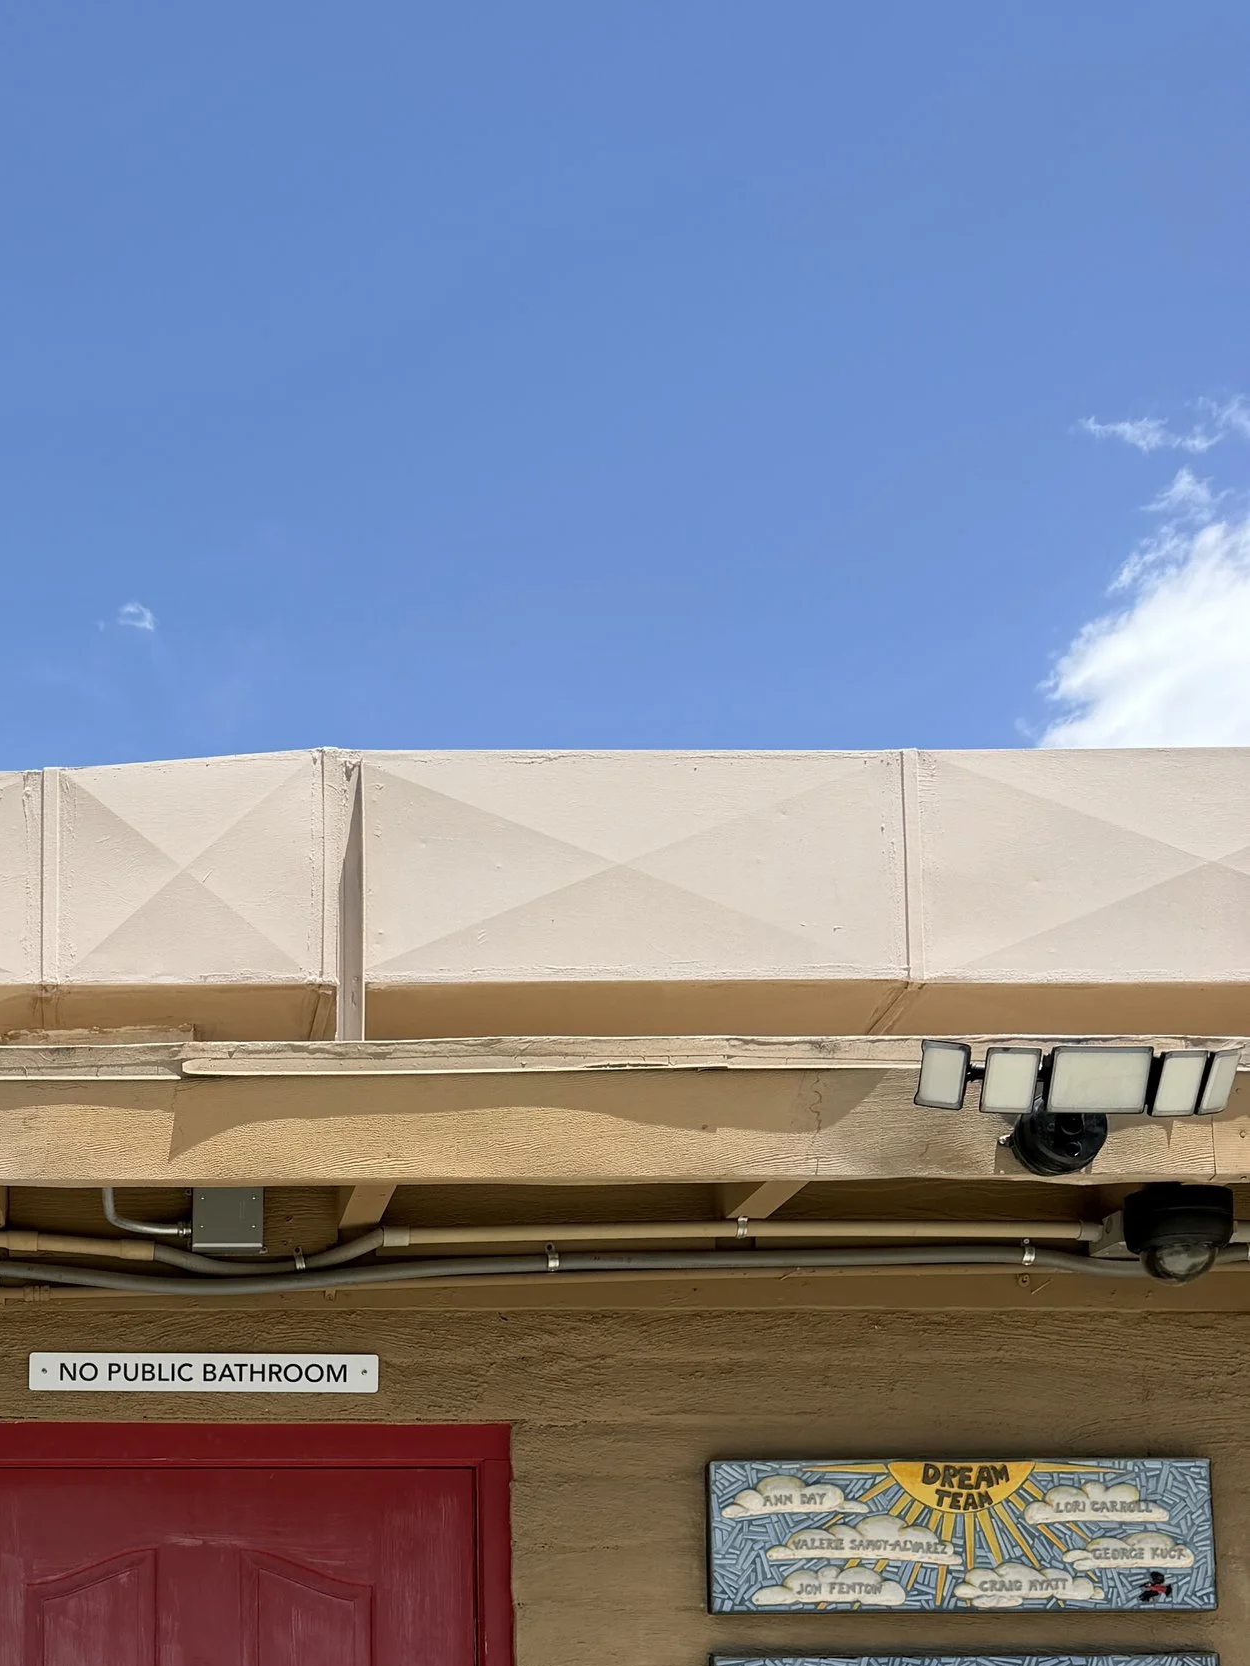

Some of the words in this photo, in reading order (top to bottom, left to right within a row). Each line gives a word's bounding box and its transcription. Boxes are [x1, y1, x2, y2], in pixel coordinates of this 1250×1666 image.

[60, 1363, 98, 1381] NO
[108, 1363, 193, 1382] PUBLIC
[203, 1364, 348, 1383] BATHROOM
[921, 1462, 1011, 1487] DREAM
[762, 1493, 792, 1506] ANN
[935, 1487, 993, 1511] TEAM
[1055, 1501, 1085, 1513] LORI
[1091, 1500, 1152, 1512] CARROLL
[793, 1538, 845, 1550] VALERIE
[1093, 1548, 1144, 1559] GEORGE
[1151, 1547, 1186, 1559] KUCK
[797, 1583, 822, 1594] JON
[829, 1582, 883, 1594] FENTON
[979, 1579, 1021, 1592] CRAIG
[1029, 1579, 1068, 1590] HYATT
